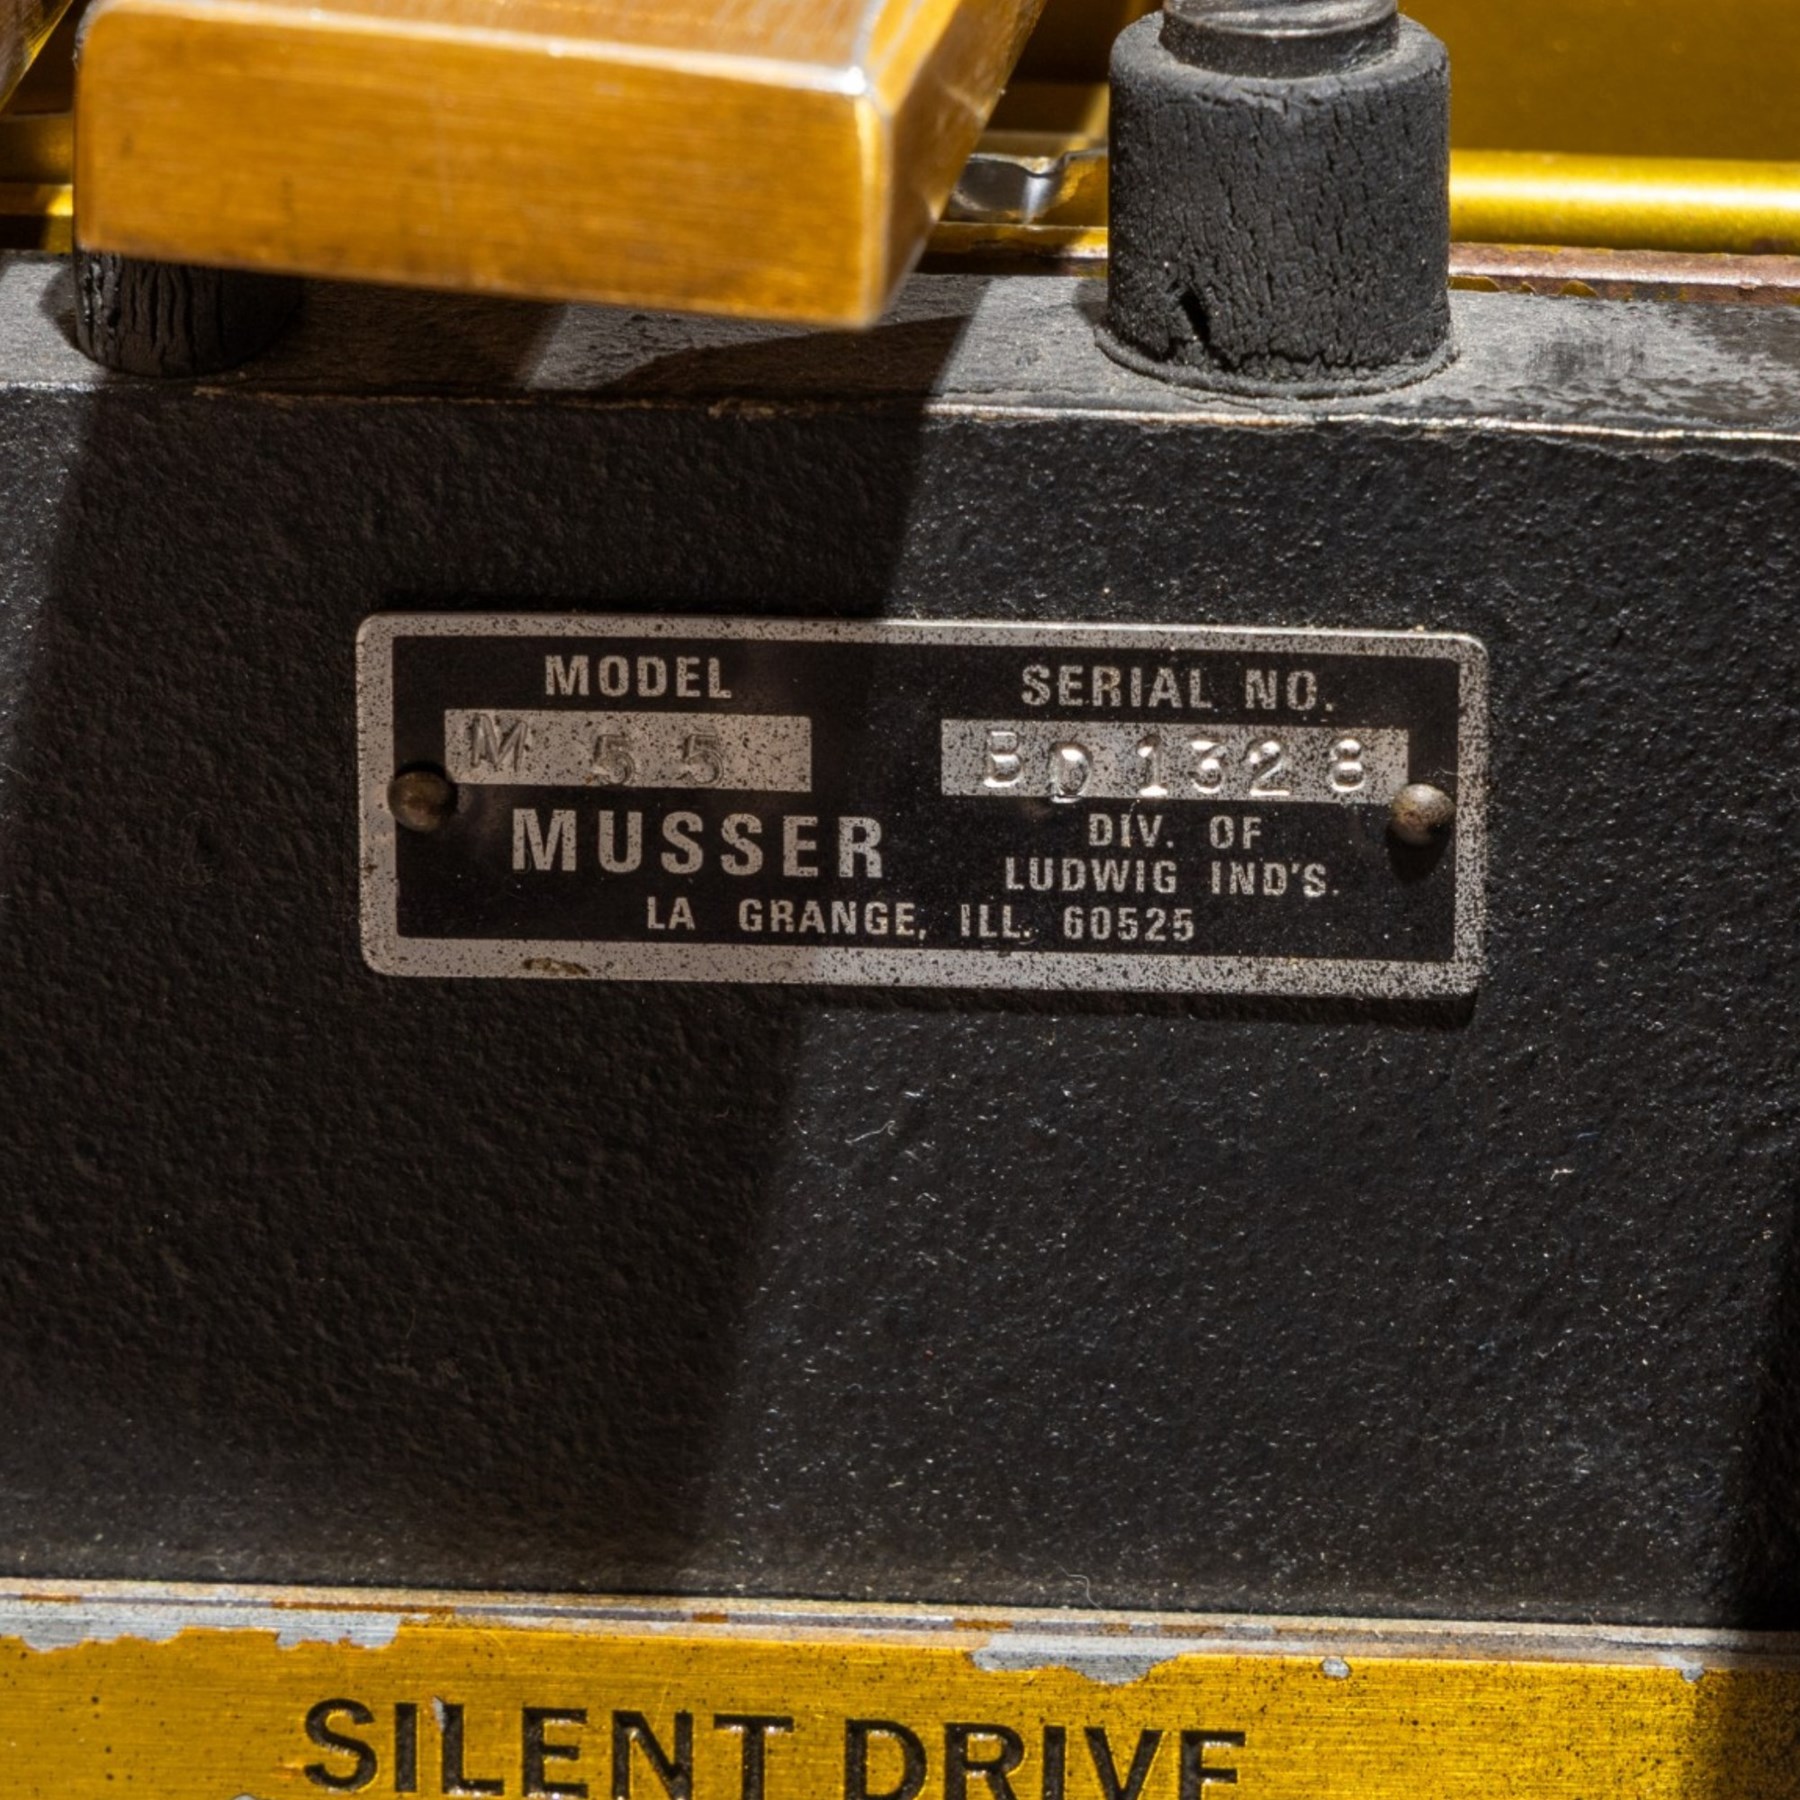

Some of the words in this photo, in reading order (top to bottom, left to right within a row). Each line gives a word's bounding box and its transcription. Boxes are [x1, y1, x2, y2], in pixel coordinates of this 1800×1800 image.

[545, 654, 732, 698] MODEL
[1021, 664, 1213, 710] SERIAL
[1245, 669, 1335, 712] NO.
[511, 808, 884, 879] MUSSER
[1088, 813, 1175, 849] DIV.
[1209, 815, 1263, 850] OF
[1005, 856, 1178, 894] LUDWIG
[1211, 862, 1340, 898] IND'S.
[646, 896, 696, 930] LA
[738, 897, 927, 941] GRANGE,
[960, 903, 1032, 940] ILL.
[1063, 906, 1195, 942] 60525
[304, 1697, 795, 1800] SILENT
